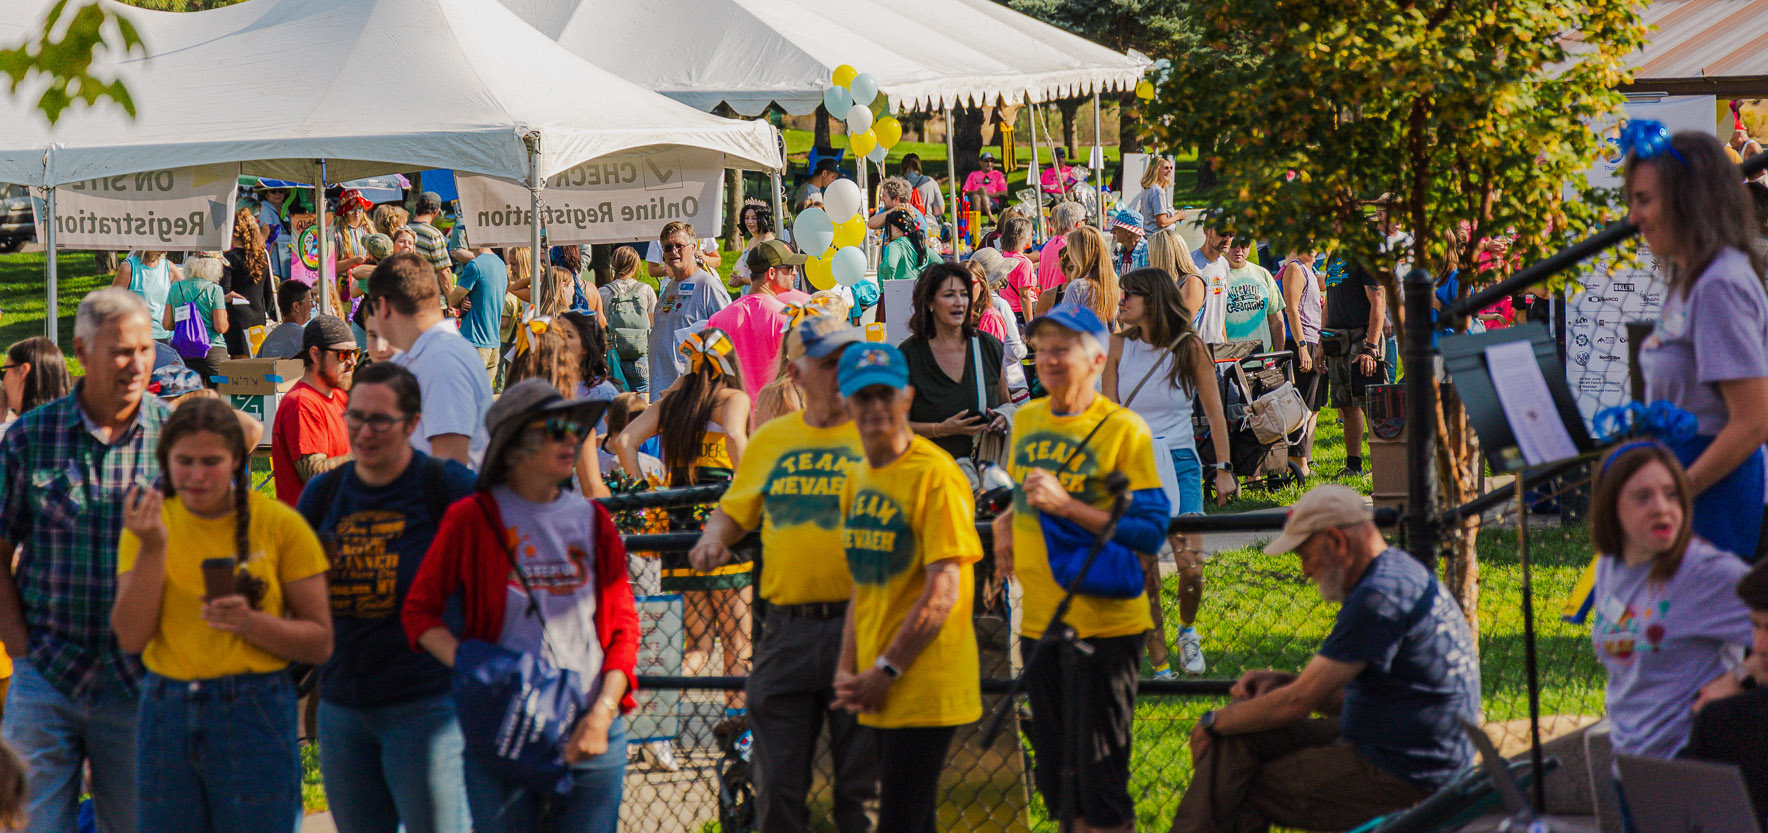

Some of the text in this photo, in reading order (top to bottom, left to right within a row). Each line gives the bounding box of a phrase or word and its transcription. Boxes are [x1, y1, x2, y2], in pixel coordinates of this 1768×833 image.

[781, 453, 854, 474] TEAM
[769, 475, 848, 495] NEVAE
[853, 495, 898, 526] EAM
[845, 528, 896, 553] EVAEH
